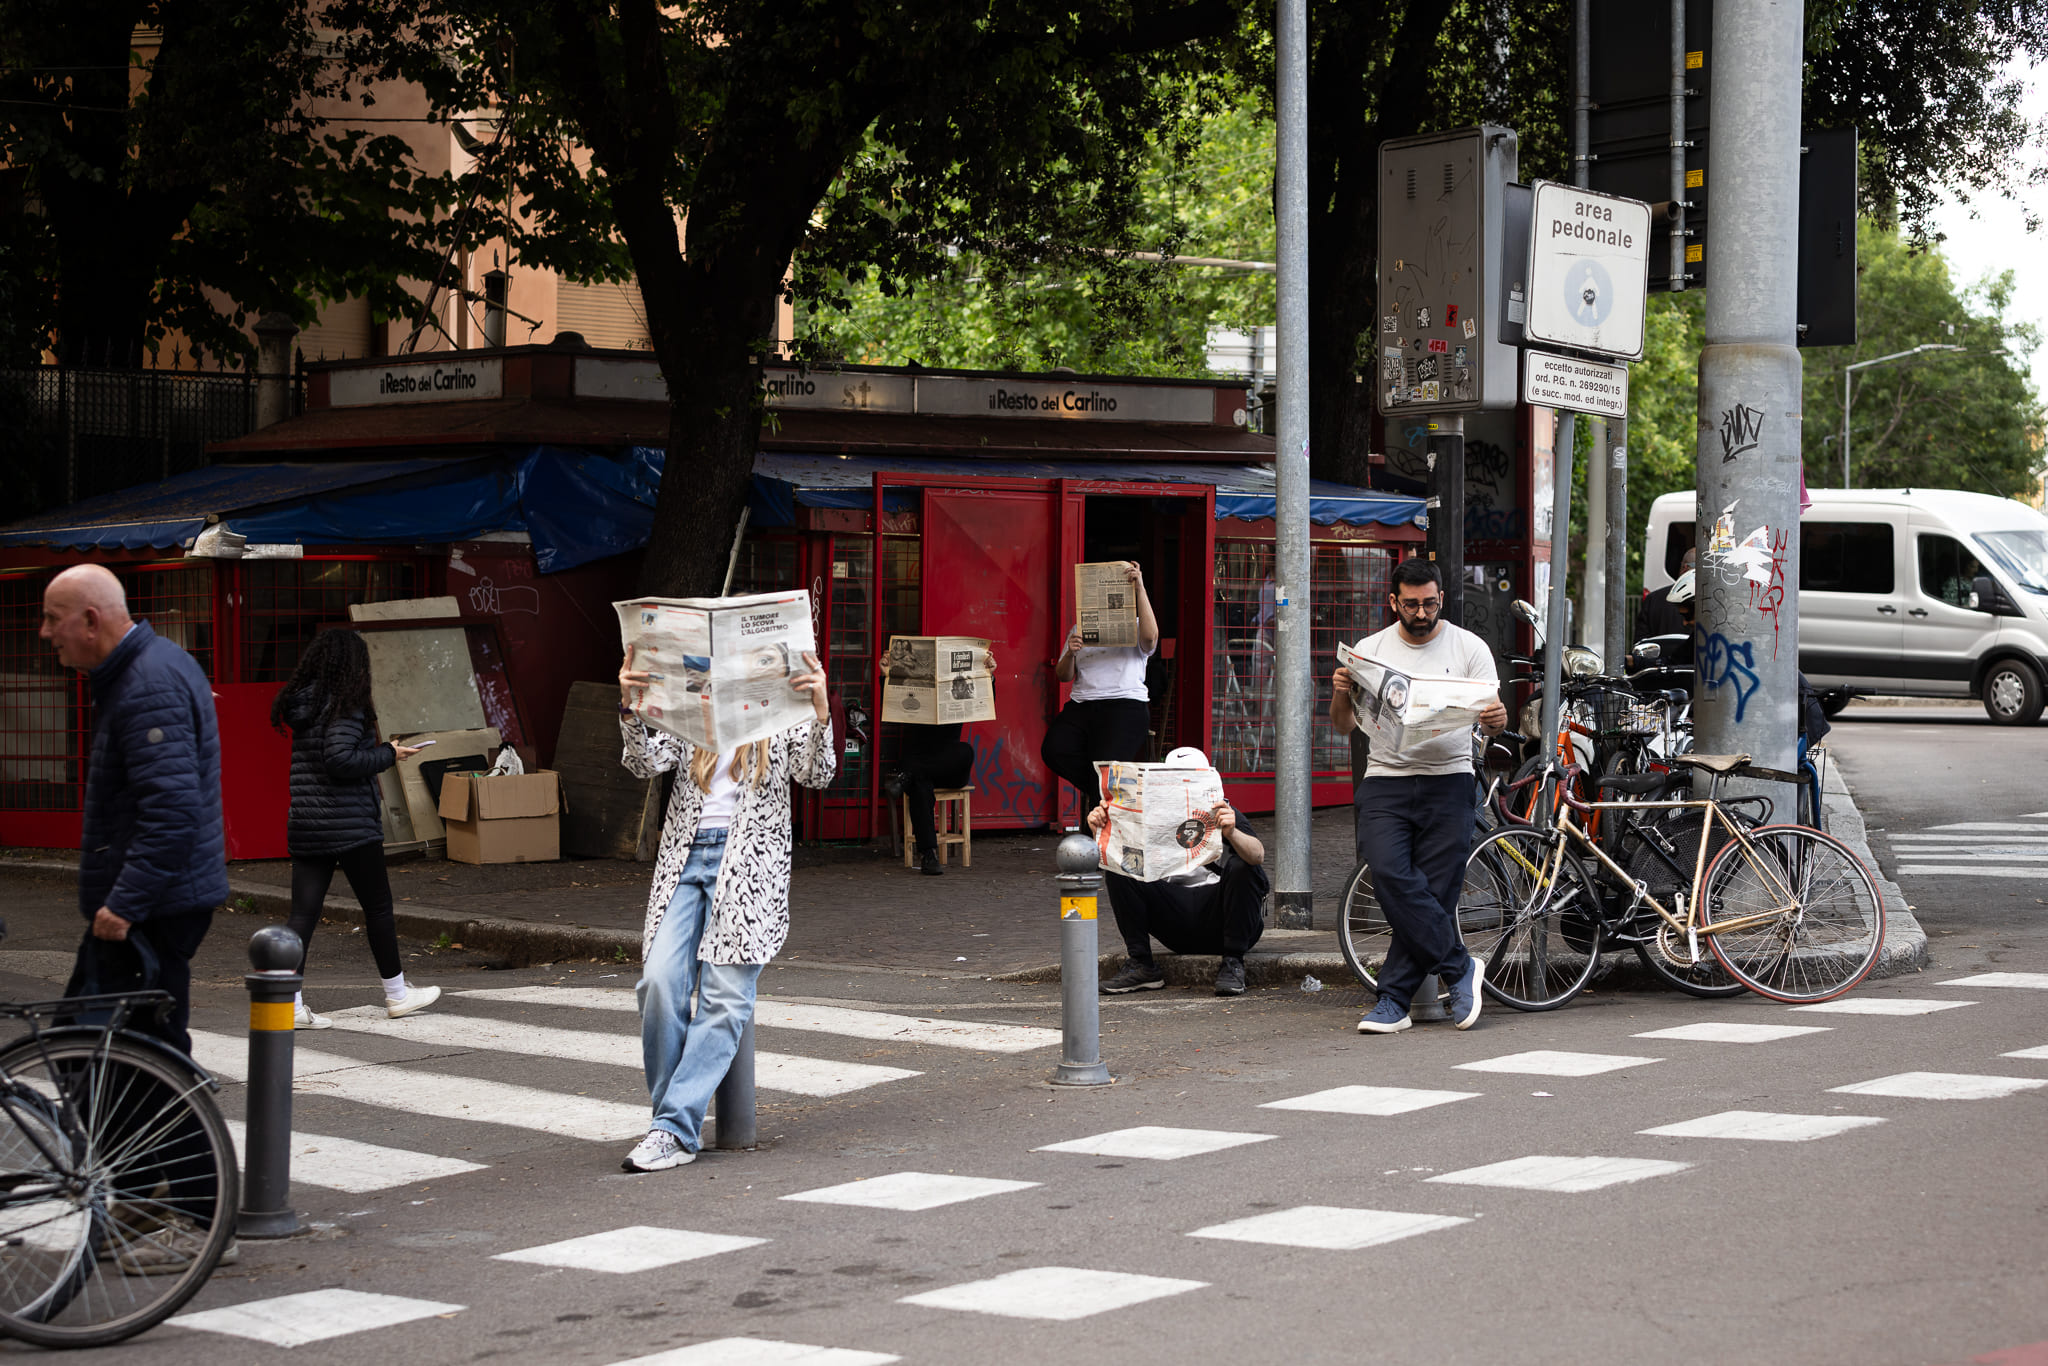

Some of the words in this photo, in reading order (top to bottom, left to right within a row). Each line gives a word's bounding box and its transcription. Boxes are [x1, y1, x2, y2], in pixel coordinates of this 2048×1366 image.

[1575, 201, 1612, 222] area
[1552, 219, 1633, 249] pedonale
[380, 378, 385, 394] il
[386, 372, 416, 394] Resto
[418, 376, 432, 392] del
[434, 368, 476, 391] Carlino
[1544, 361, 1573, 374] eccetto
[1574, 367, 1613, 381] autorizzati
[1535, 374, 1551, 384] ord.
[1553, 375, 1568, 386] P.G.
[1569, 380, 1577, 388] n.
[1579, 380, 1621, 395] 269290/15
[989, 394, 996, 410] il
[997, 389, 1038, 411] Resto
[1041, 395, 1059, 411] del
[1063, 390, 1117, 412] Carlino
[1532, 386, 1540, 396] (e
[1542, 388, 1562, 399] succ.
[1564, 392, 1583, 403] mod.
[1585, 396, 1595, 405] ed
[1596, 397, 1623, 410] integr.)
[749, 612, 779, 621] TUMORE
[752, 619, 775, 628] SCOVA
[741, 624, 789, 636] L'ALGORITMO
